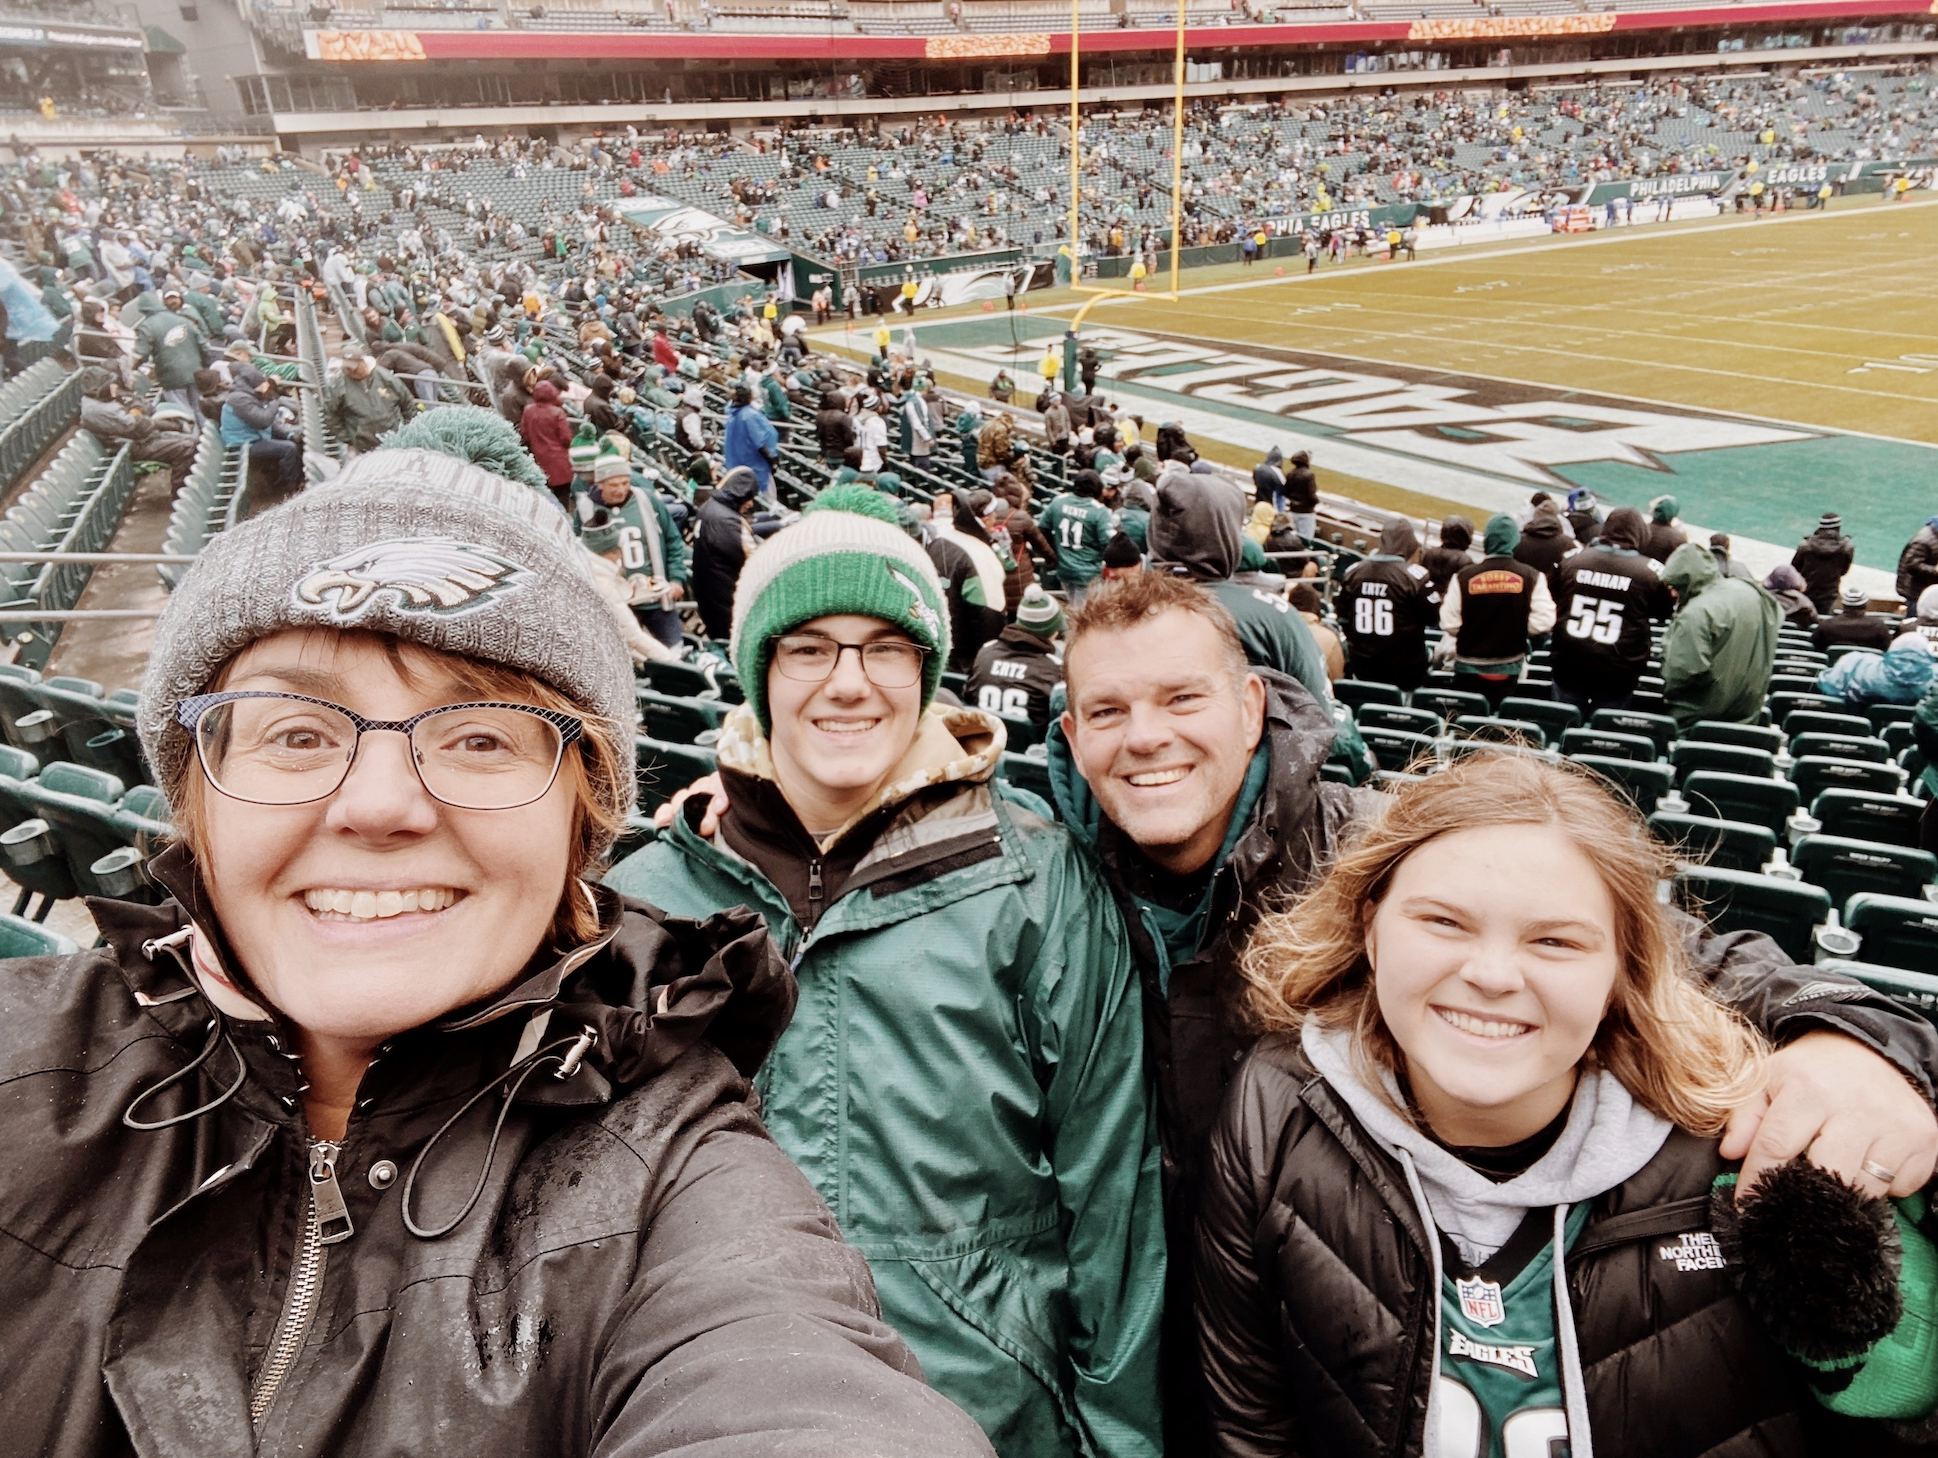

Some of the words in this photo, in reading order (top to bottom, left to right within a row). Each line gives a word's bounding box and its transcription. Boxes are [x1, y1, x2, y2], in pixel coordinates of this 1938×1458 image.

[1629, 175, 1721, 197] PHILADELPHIA
[1767, 166, 1828, 184] EAGLES
[1059, 518, 1084, 550] 11
[1361, 582, 1388, 597] ERTZ
[1576, 569, 1632, 592] GRAHAM
[1355, 597, 1393, 636] 86
[1566, 594, 1625, 644] 55
[990, 660, 1028, 680] ERTZ
[1678, 1233, 1711, 1246] THE
[1659, 1245, 1714, 1260] NORTH
[1676, 1256, 1717, 1271] FACE
[1467, 1300, 1497, 1319] NFL
[1449, 1328, 1538, 1378] EAGLES
